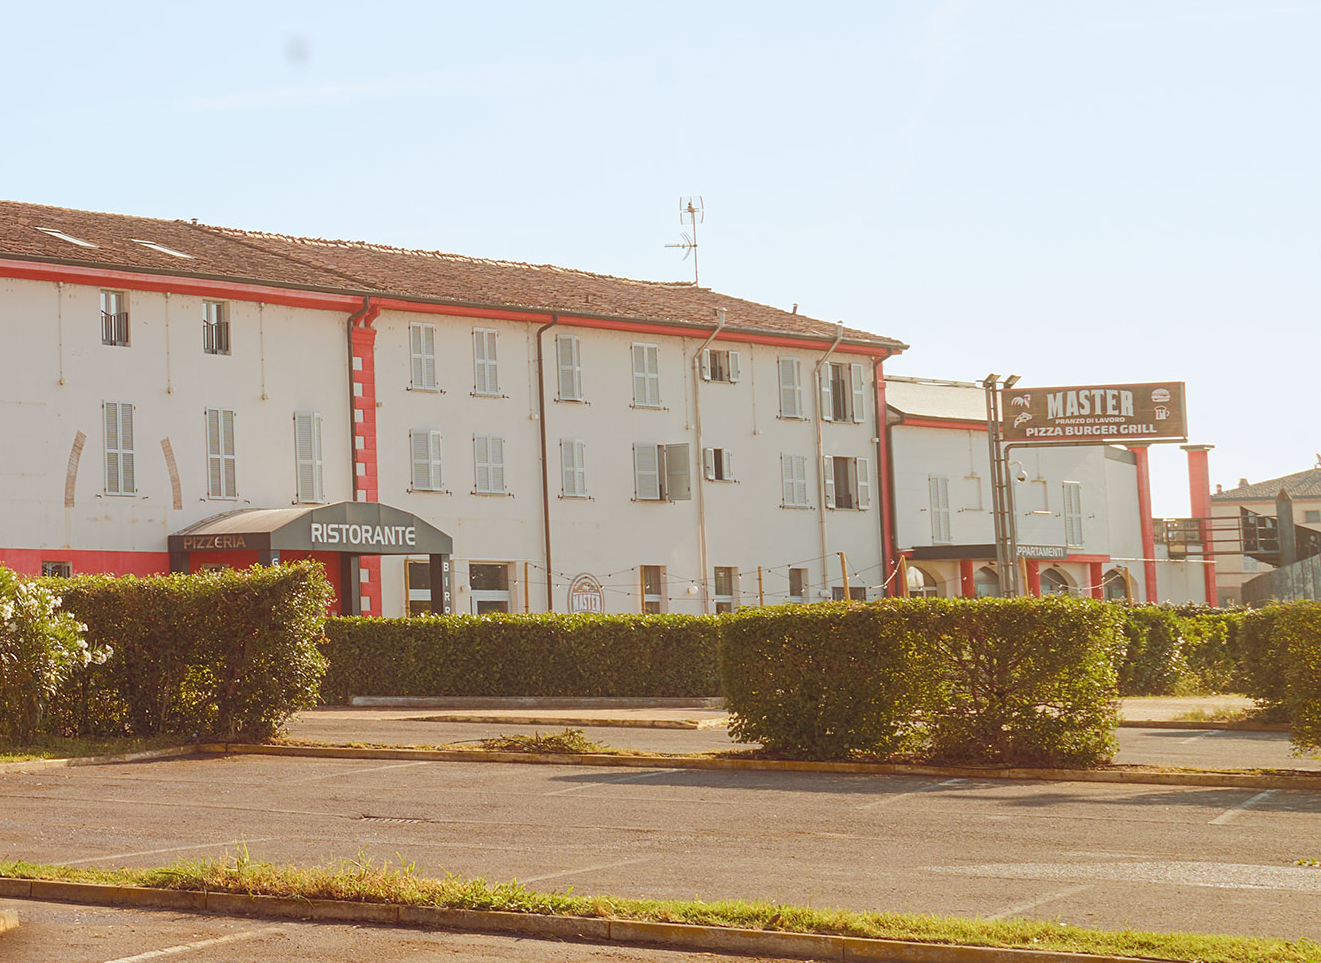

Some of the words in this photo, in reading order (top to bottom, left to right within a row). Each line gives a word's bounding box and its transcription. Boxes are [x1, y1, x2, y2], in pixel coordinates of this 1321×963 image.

[1046, 389, 1134, 420] MASTER
[1096, 416, 1126, 424] LAVORO
[1026, 426, 1063, 437] PIZZA
[1065, 425, 1118, 435] BURGER
[1119, 424, 1157, 434] GRILL
[311, 522, 416, 546] RISTORANTE
[183, 536, 247, 550] PIZZERIA
[1016, 546, 1064, 557] PPARTAMENTI
